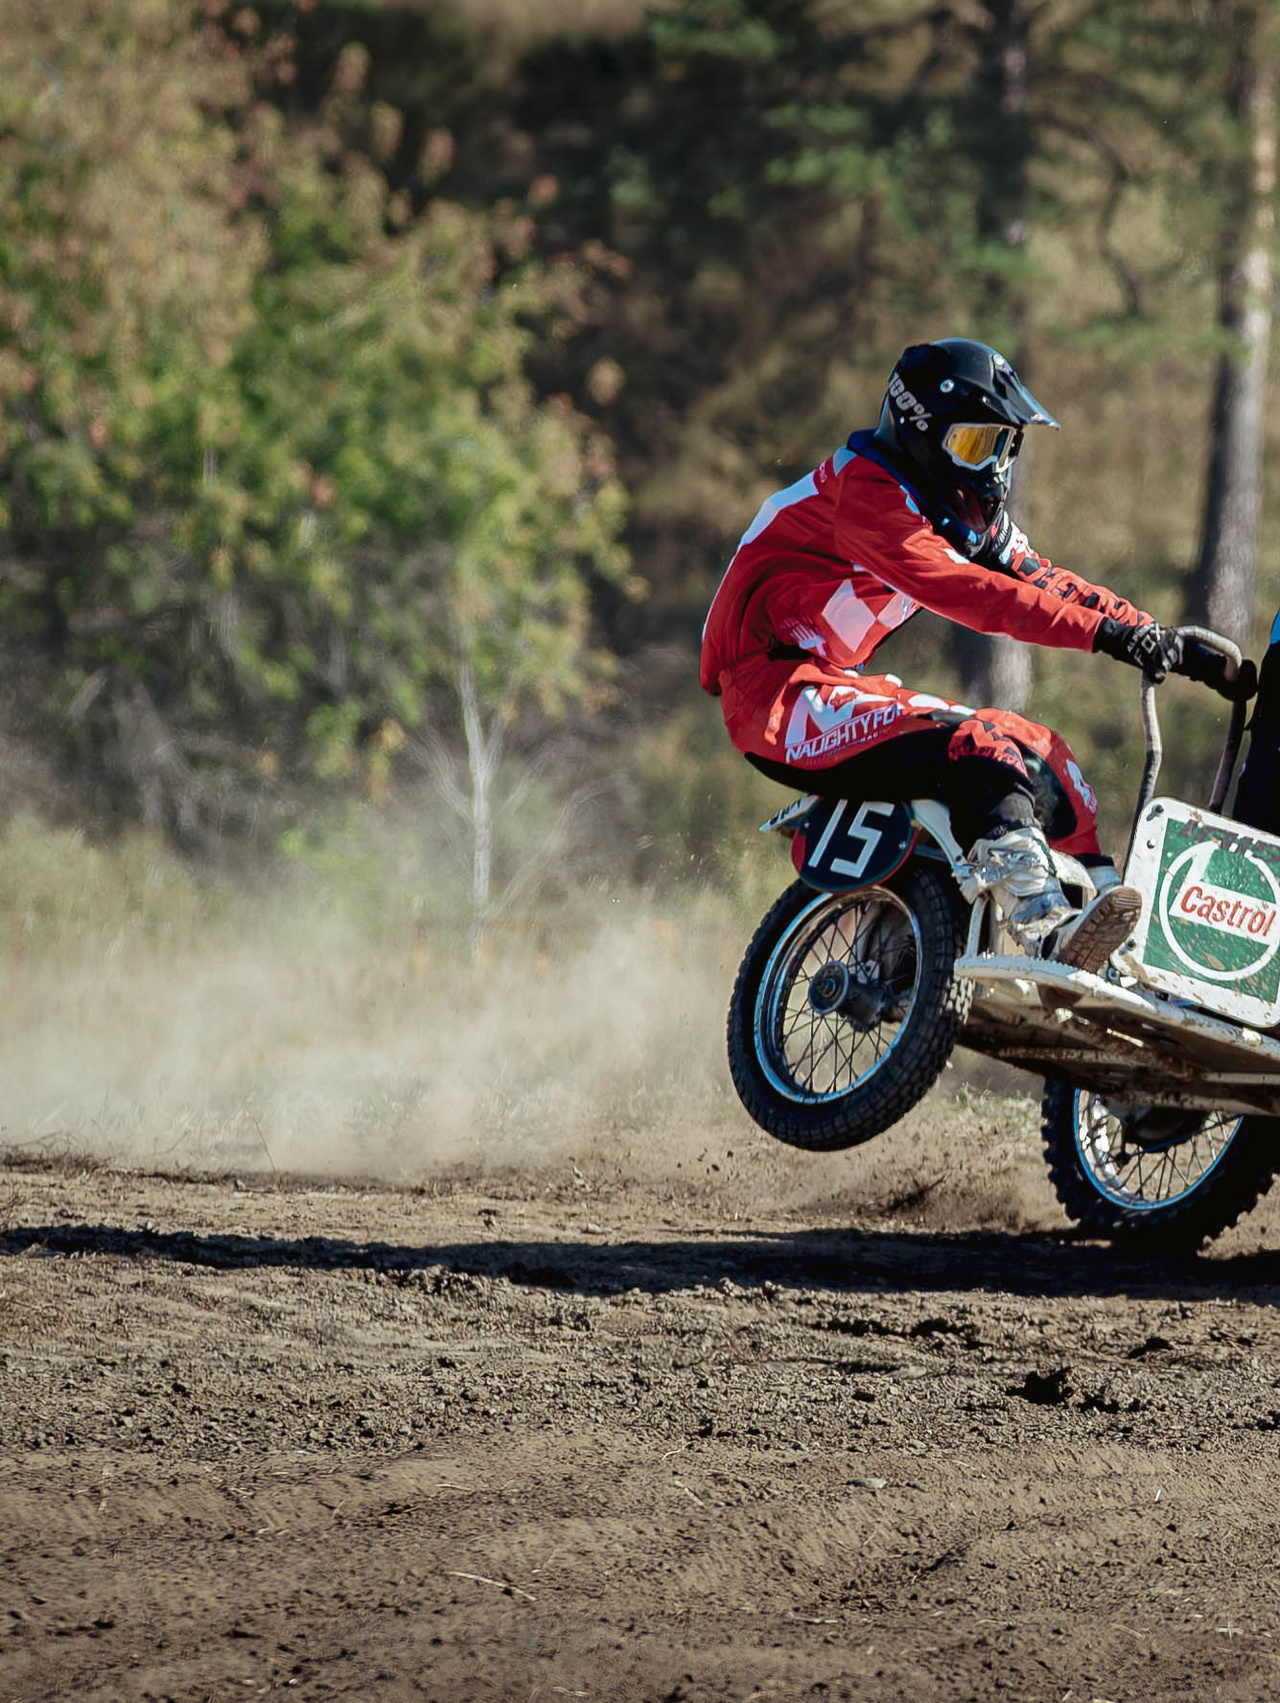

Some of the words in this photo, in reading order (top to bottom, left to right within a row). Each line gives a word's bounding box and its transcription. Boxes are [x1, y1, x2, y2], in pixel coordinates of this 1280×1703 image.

[1134, 622, 1166, 667] FOX
[808, 799, 895, 878] 15
[1181, 886, 1277, 937] Castrol
